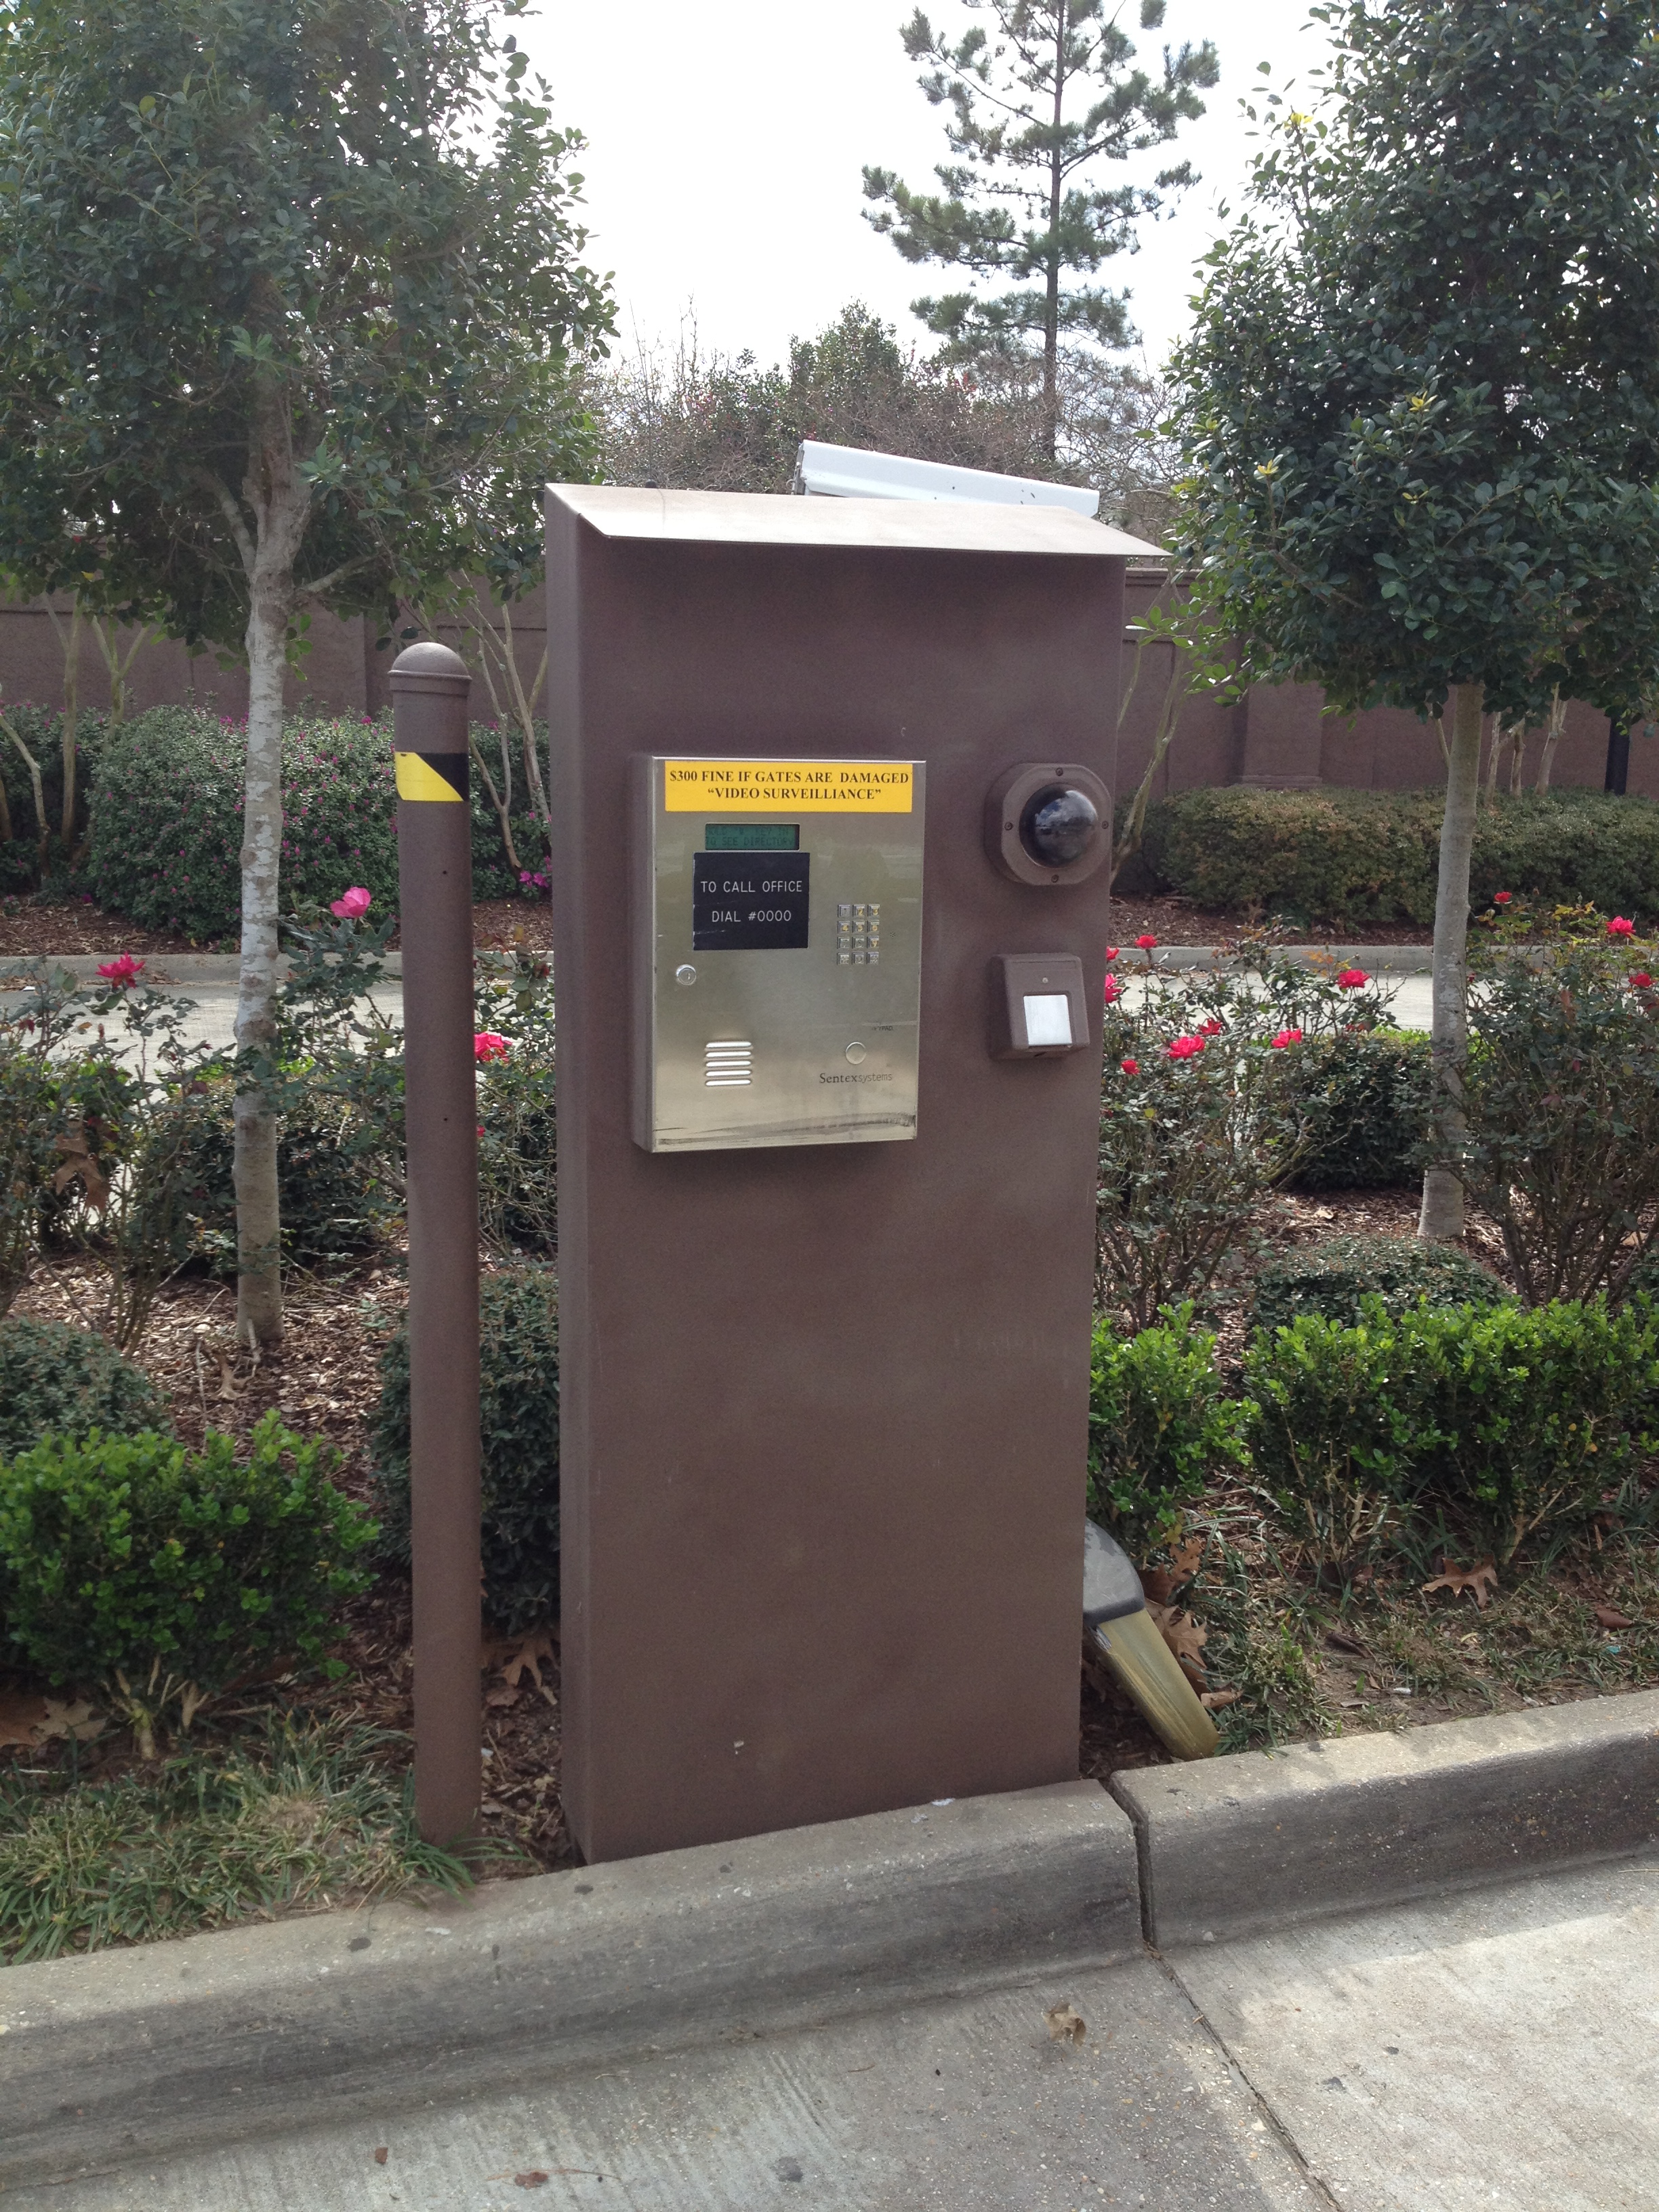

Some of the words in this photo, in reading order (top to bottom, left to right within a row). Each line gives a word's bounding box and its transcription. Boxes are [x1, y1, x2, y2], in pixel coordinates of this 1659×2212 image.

[670, 770, 697, 781] $300
[702, 771, 734, 782] FINE
[739, 771, 752, 782] IF
[755, 771, 801, 783] GATES
[805, 772, 833, 783] ARE
[840, 772, 909, 783] DAMAGED
[708, 787, 760, 799] “VIDEO
[722, 836, 738, 846] SEE
[743, 836, 794, 846] DIRECTORY
[700, 881, 717, 893] TO
[722, 881, 756, 893] CALL
[762, 881, 802, 893] OFFICE
[712, 910, 741, 922] DIAL
[747, 910, 792, 922] #0000
[819, 1072, 893, 1084] Sentexsystems
